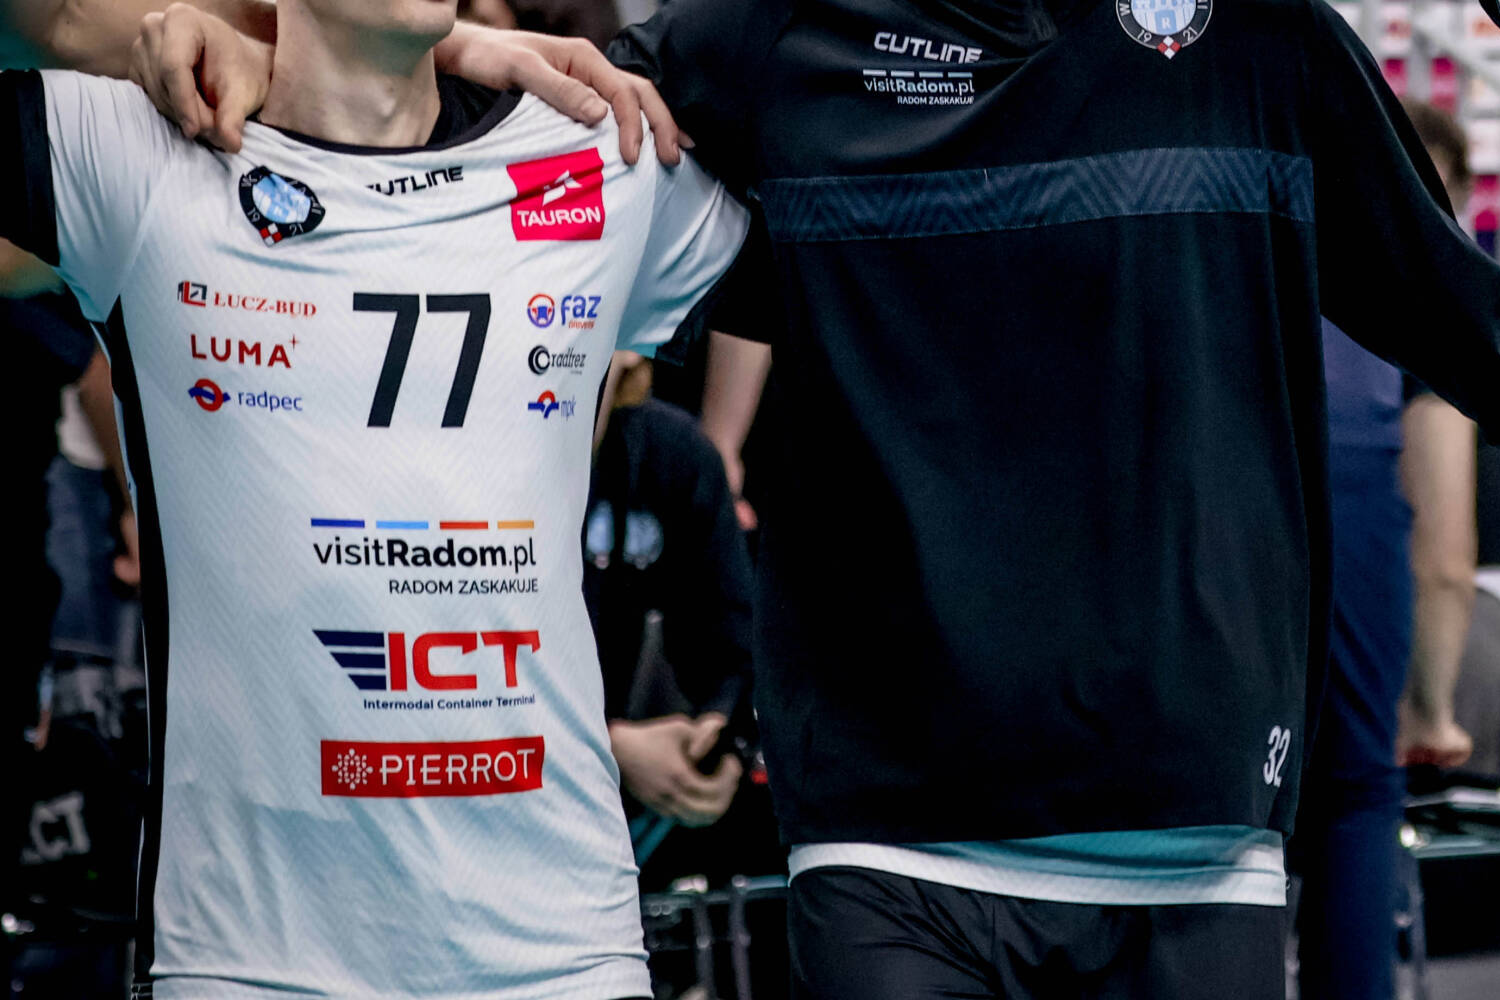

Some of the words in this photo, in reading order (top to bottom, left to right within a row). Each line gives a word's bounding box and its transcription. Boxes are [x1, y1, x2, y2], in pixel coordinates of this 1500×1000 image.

[874, 31, 983, 64] CUTLINE
[863, 78, 975, 96] visitRadom.pl
[365, 166, 464, 197] UTLINE
[517, 205, 602, 228] TAURON
[560, 294, 602, 325] faz
[352, 292, 491, 428] 77
[238, 391, 303, 412] radpec
[313, 536, 537, 574] visitRadom.pl
[389, 579, 453, 595] RADOM
[458, 578, 539, 595] ZASKAKUJE
[388, 630, 541, 691] ICT
[363, 699, 434, 711] Intermodal
[437, 698, 493, 710] Container
[496, 694, 536, 706] Terminal
[379, 748, 536, 786] PIERROT
[1263, 725, 1291, 788] 32
